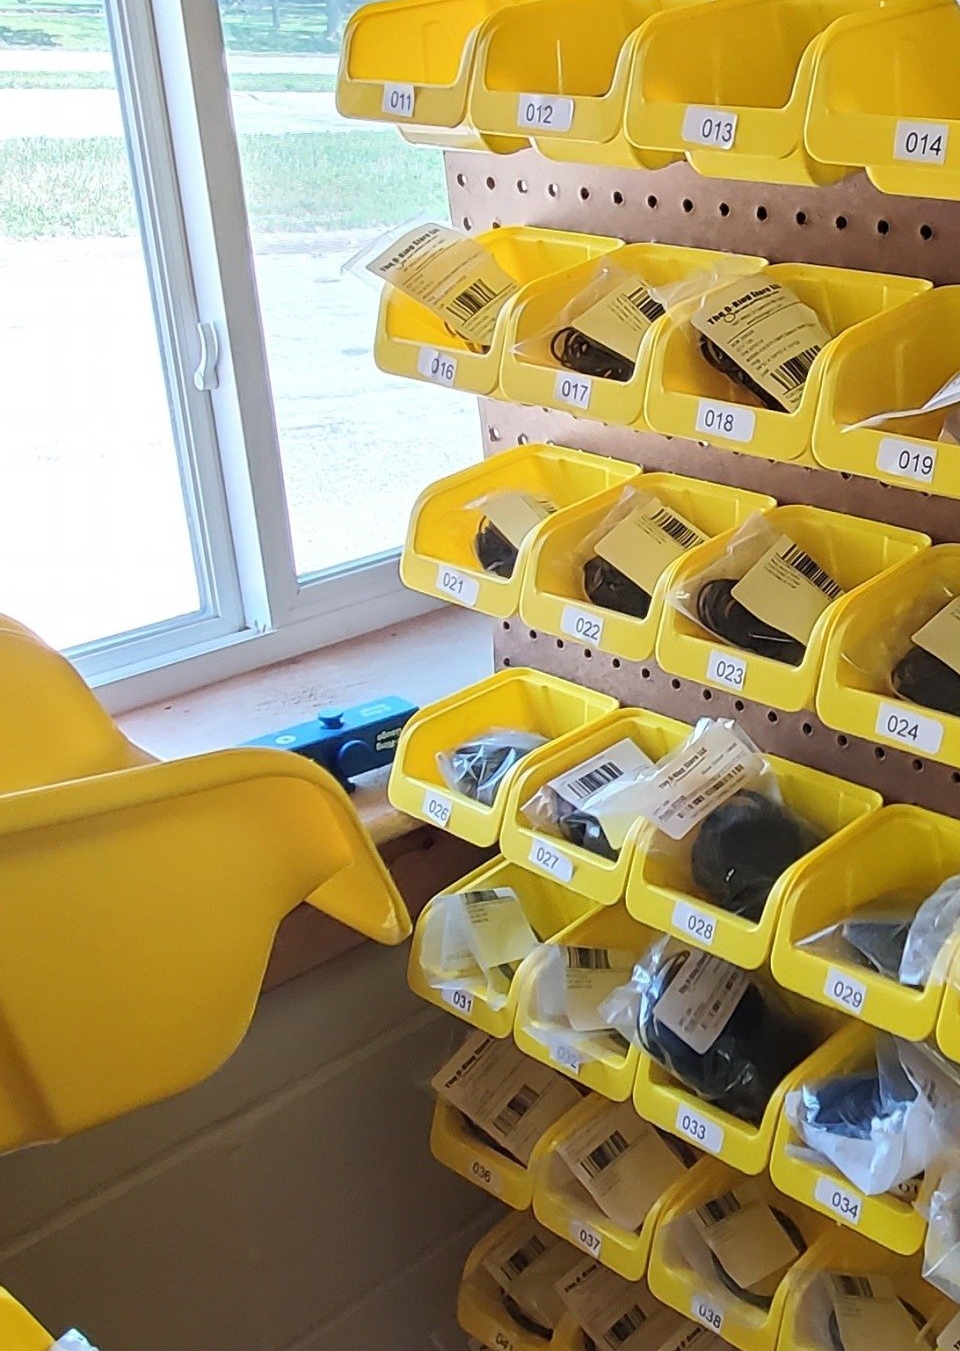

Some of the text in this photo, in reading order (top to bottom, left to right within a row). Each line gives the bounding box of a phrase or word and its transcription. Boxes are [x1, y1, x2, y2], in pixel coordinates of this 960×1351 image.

[389, 91, 412, 112] 011
[525, 104, 553, 125] 012
[701, 118, 733, 143] 013
[904, 132, 942, 158] 014
[706, 311, 726, 325] The
[430, 356, 455, 381] 016
[560, 379, 589, 403] 017
[703, 409, 734, 434] 018
[898, 449, 934, 476] 019
[441, 571, 464, 594] 021
[575, 616, 601, 642] 022
[715, 659, 744, 686] 023
[885, 713, 919, 742] 024
[428, 798, 449, 823] 026
[535, 846, 559, 870] 027
[686, 914, 714, 940] 028
[452, 989, 473, 1012] 031
[832, 980, 863, 1008] 029
[681, 1114, 706, 1140] 033
[471, 1160, 492, 1184] 036
[831, 1191, 859, 1220] 034
[579, 1228, 600, 1252] 037
[697, 1304, 722, 1329] 038
